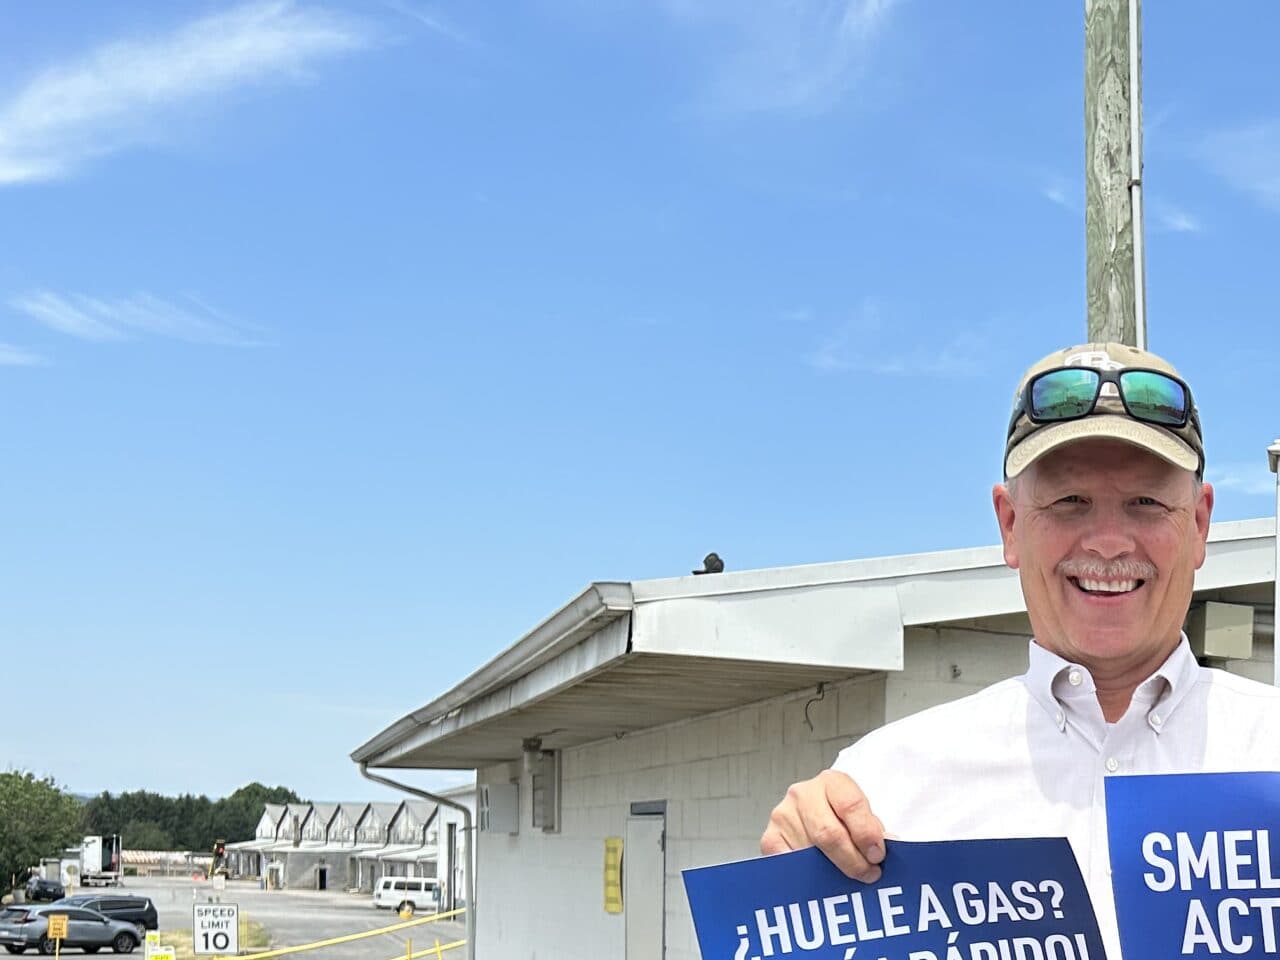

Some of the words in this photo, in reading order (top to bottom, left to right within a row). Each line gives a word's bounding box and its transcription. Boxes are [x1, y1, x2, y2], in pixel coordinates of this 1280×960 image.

[197, 908, 235, 918] SPEED
[917, 885, 953, 932] A
[953, 880, 1065, 926] GAS?
[201, 921, 231, 929] LIMIT
[202, 932, 230, 950] 10
